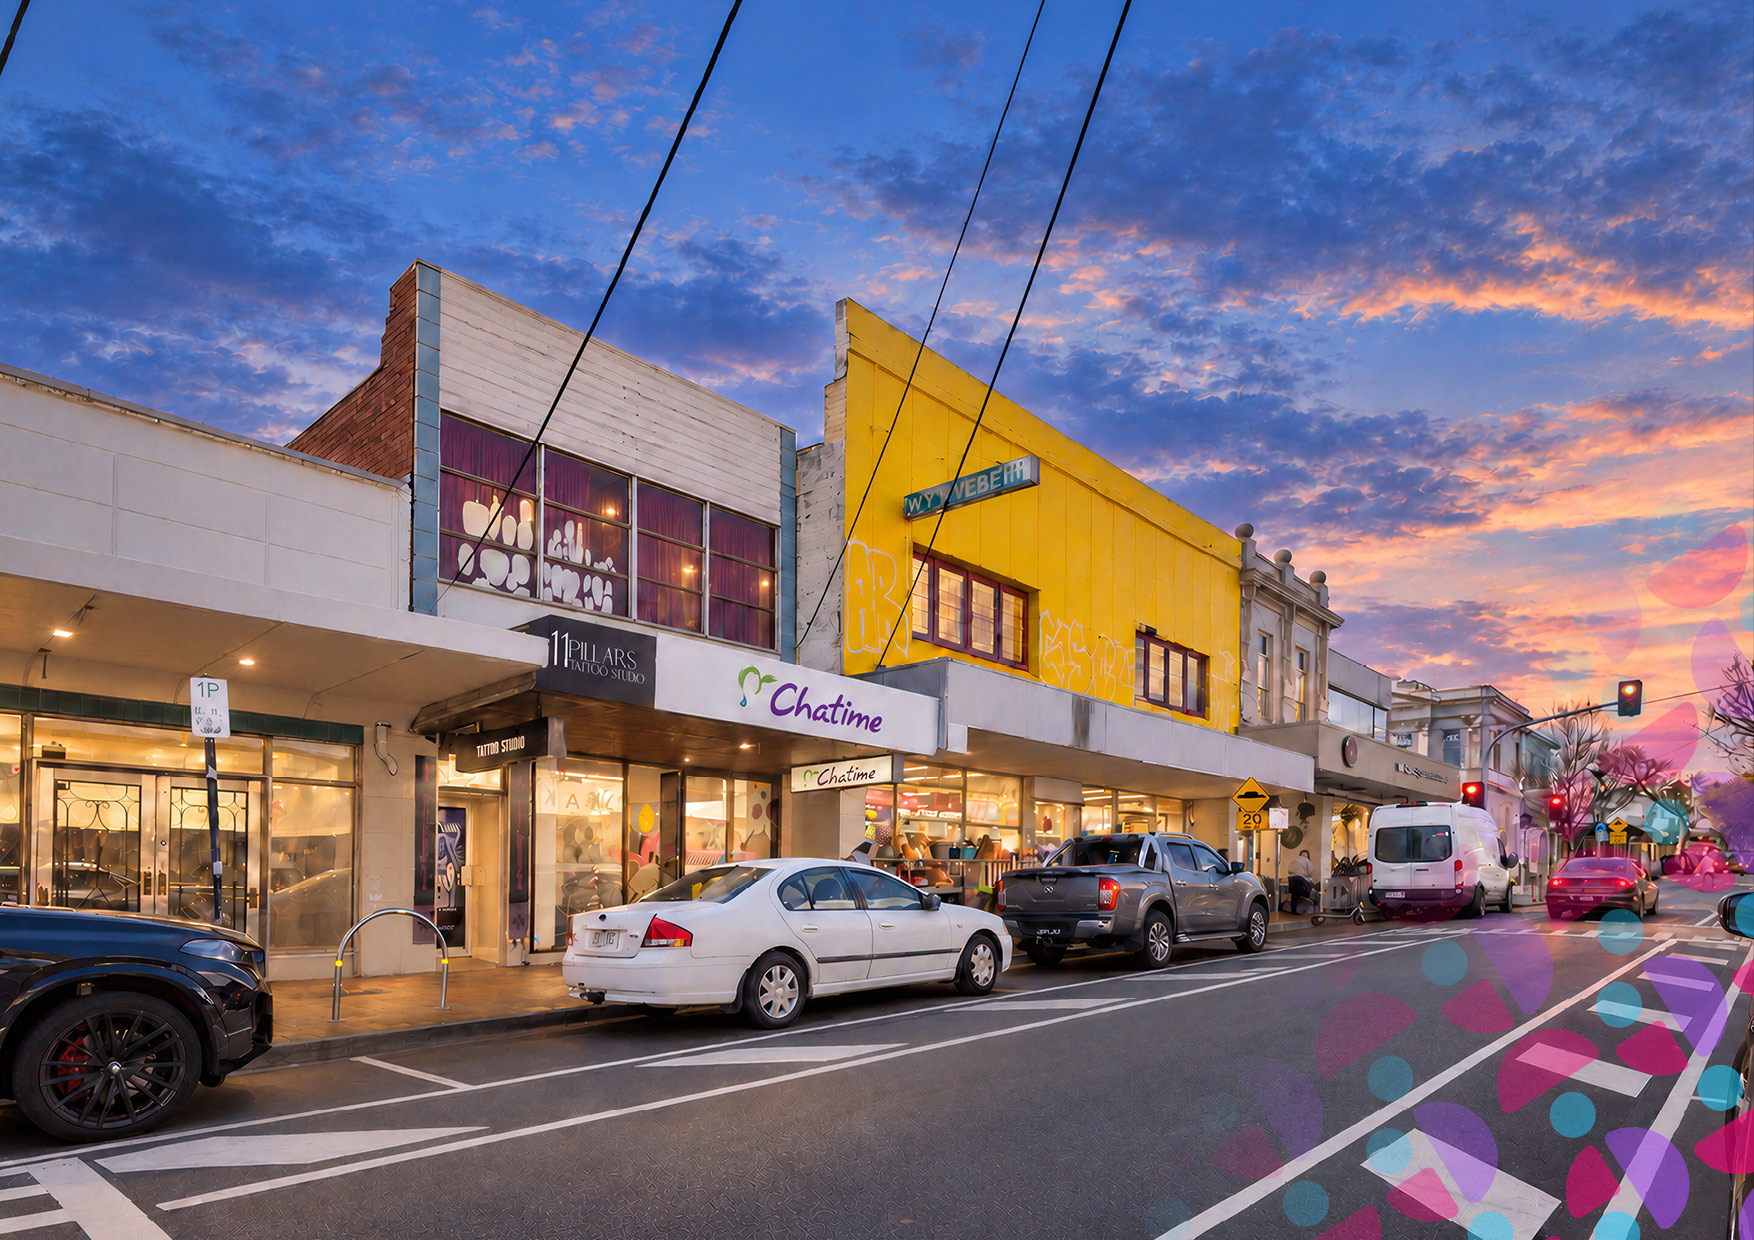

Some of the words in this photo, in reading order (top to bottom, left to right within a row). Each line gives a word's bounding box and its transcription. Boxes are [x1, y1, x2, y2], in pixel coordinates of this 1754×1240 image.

[568, 639, 637, 670] PILLARS
[568, 658, 609, 677] TATTOO
[611, 667, 646, 685] STUDIO
[197, 681, 220, 698] 1P
[770, 682, 883, 733] Chatime
[476, 741, 500, 758] TATTOO
[501, 735, 526, 753] STUDIO
[817, 765, 876, 786] Chatime
[1243, 813, 1262, 825] 20
